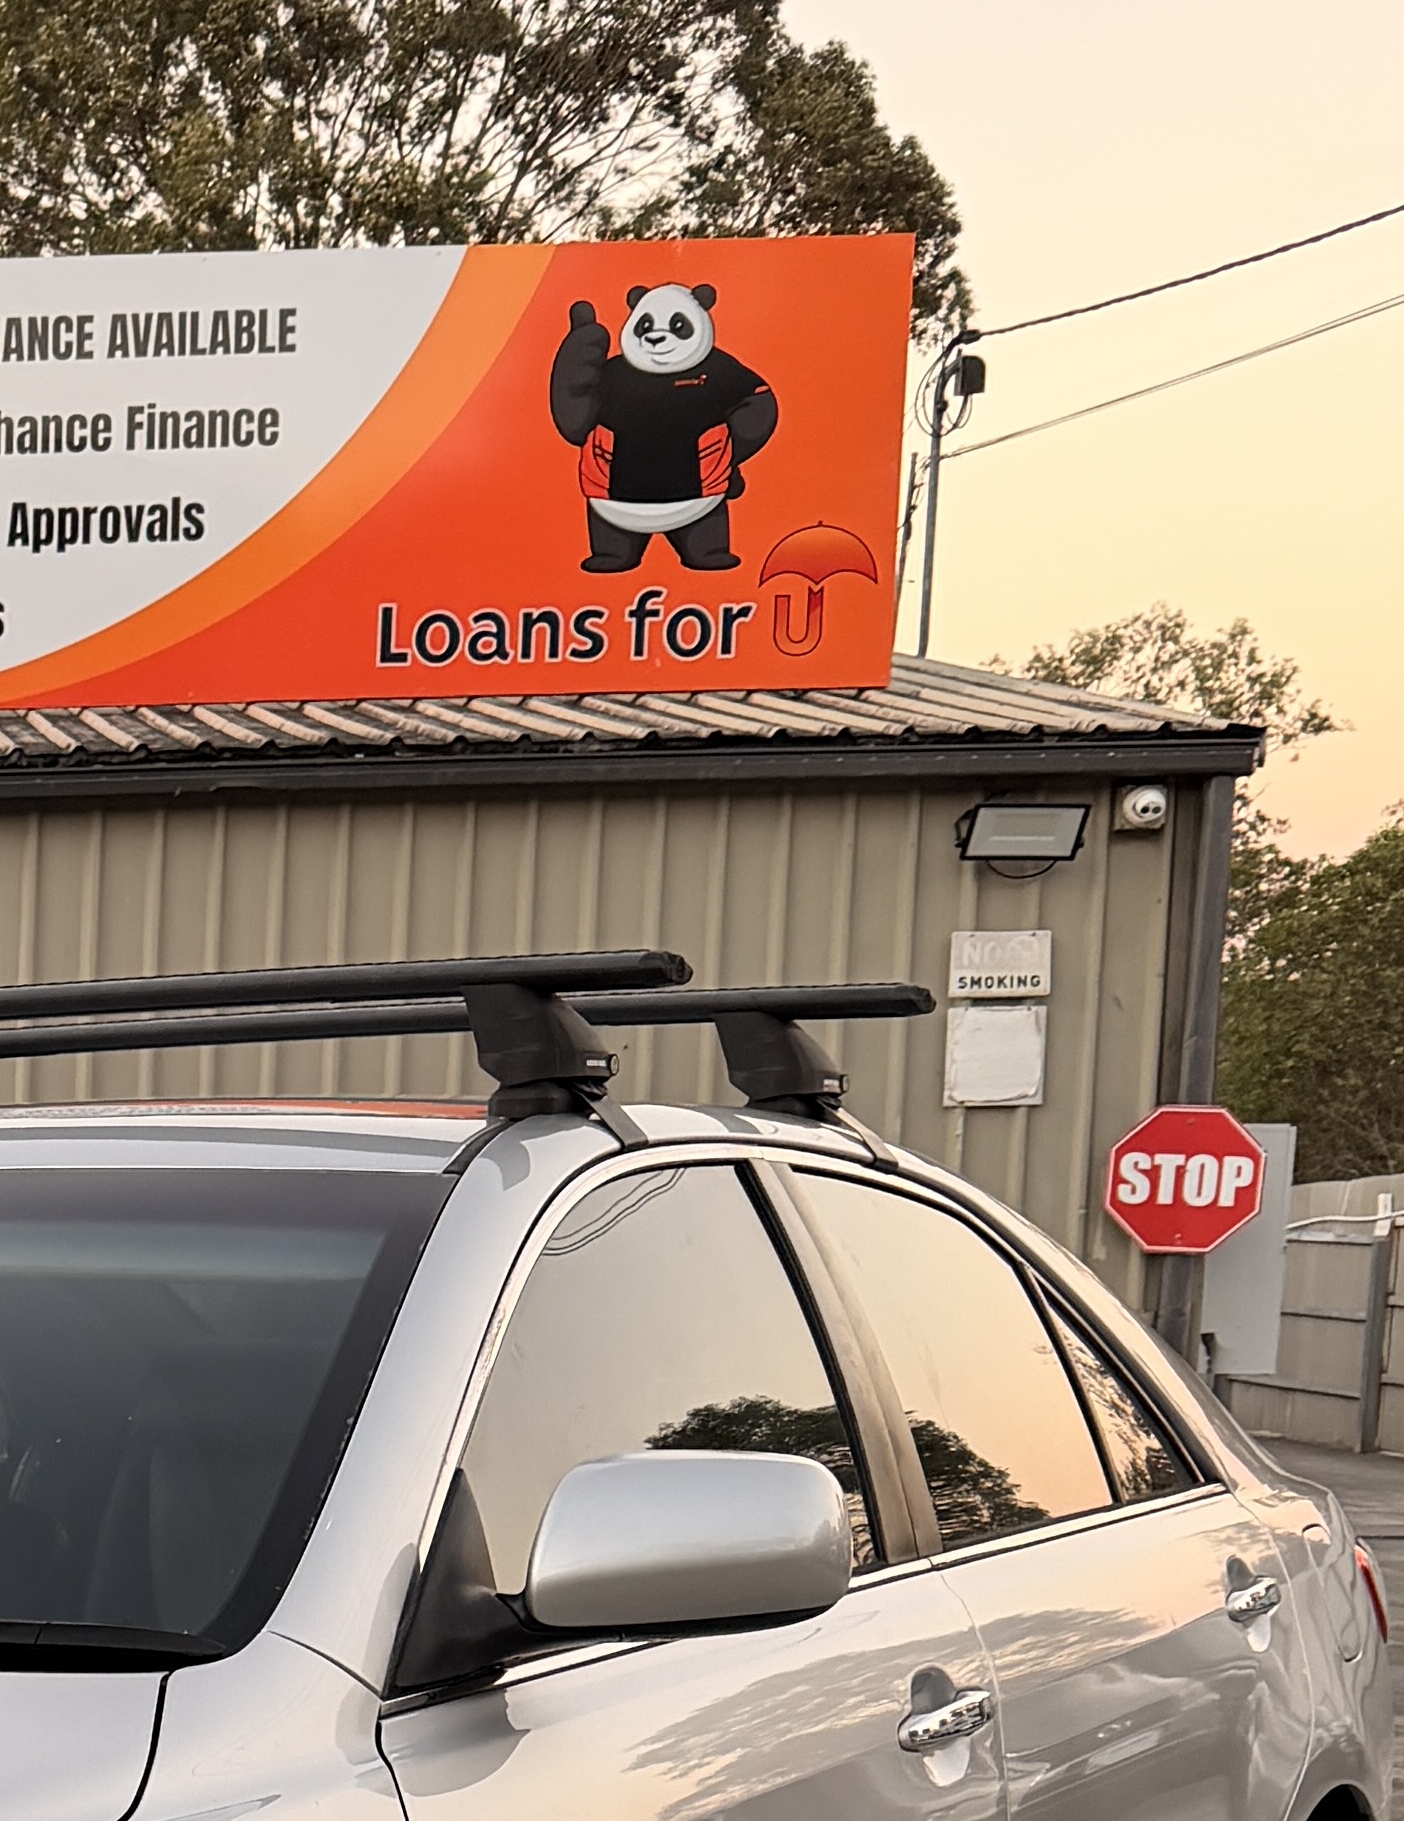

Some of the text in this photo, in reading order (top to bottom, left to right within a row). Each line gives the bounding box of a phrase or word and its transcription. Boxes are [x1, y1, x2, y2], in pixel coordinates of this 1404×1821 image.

[107, 308, 297, 359] AVAILABLE
[126, 403, 280, 451] Finance
[7, 497, 205, 553] Approvals
[376, 602, 609, 667] Loans
[624, 586, 758, 660] for
[958, 975, 1041, 989] SMOKING
[1117, 1152, 1254, 1207] STOP
